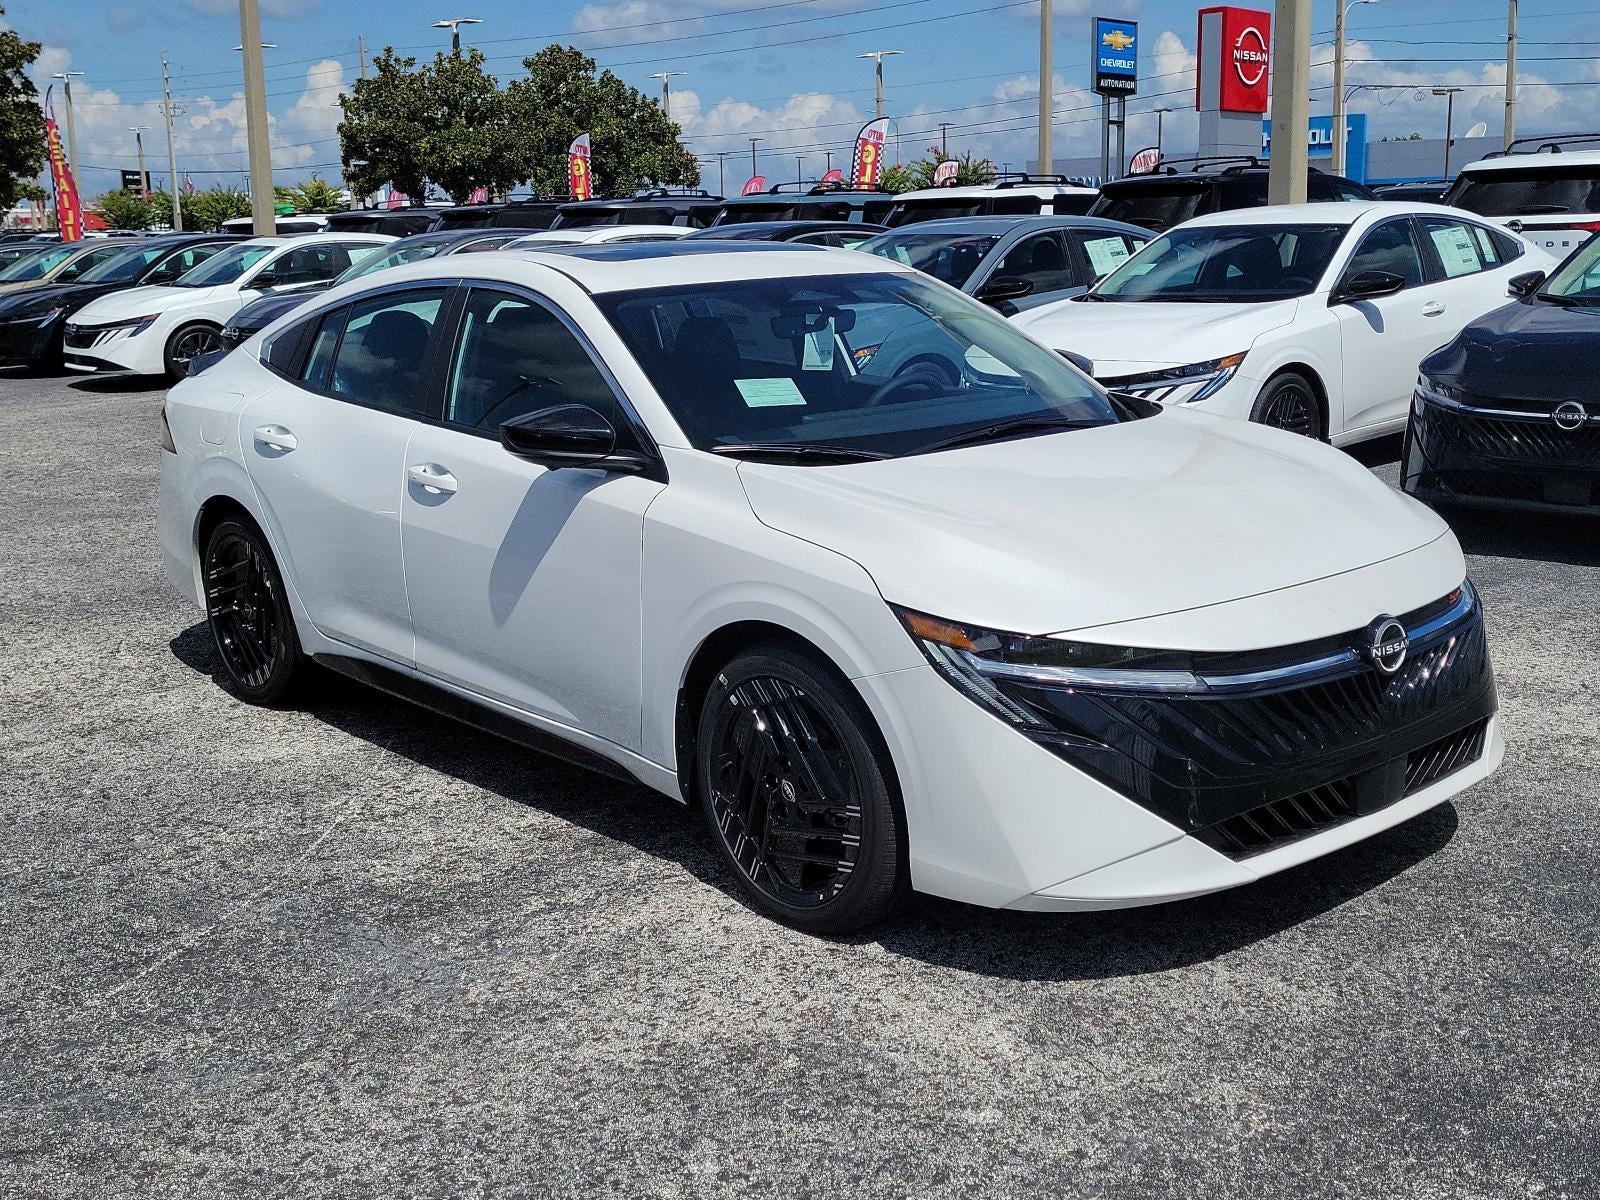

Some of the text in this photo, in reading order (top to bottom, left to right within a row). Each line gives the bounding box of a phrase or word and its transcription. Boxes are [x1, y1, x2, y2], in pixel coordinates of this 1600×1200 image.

[1233, 49, 1268, 62] NISSAN
[1100, 57, 1135, 69] CHEVROLET
[1100, 78, 1135, 89] AUTONATION
[1551, 412, 1588, 420] NISSAN
[1372, 639, 1409, 657] NISSAN
